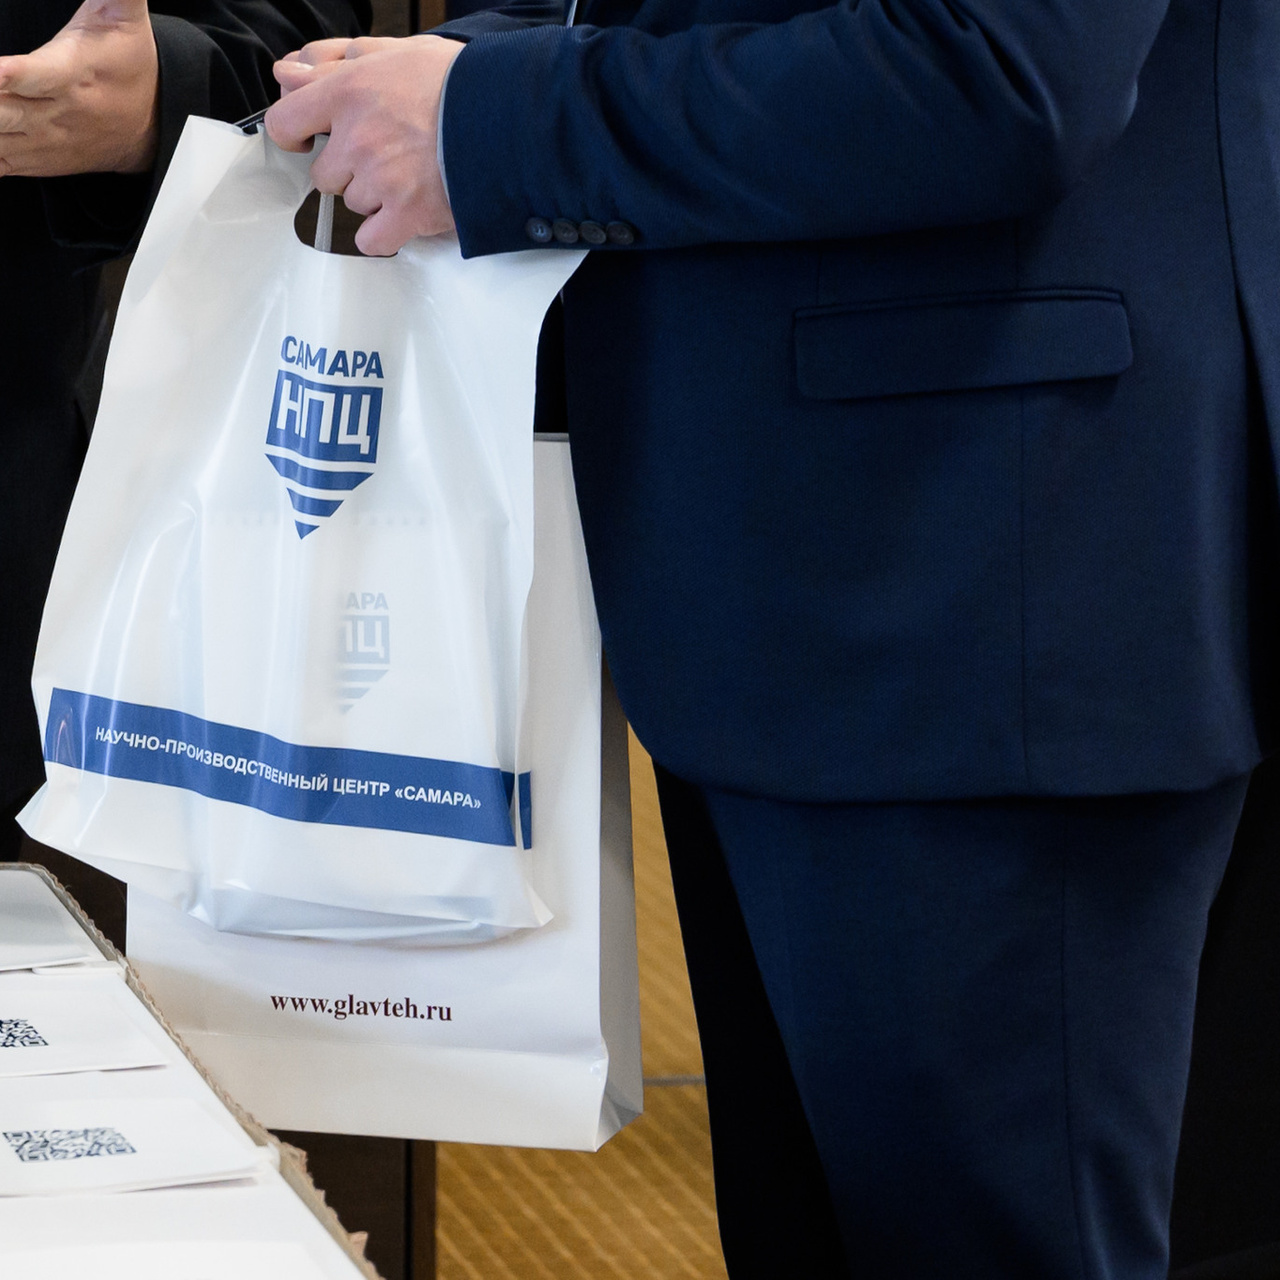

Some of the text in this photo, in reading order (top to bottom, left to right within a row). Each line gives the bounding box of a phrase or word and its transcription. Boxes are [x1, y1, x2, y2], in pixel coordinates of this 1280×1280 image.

[280, 335, 385, 379] САМАРА
[275, 378, 371, 456] НПЦ
[95, 726, 482, 810] НАУЧНО-ПРОИЗВОДСТВЕННЫЙ ЦЕНТР «САМАРА»
[270, 994, 453, 1021] www.glavteh.ru
